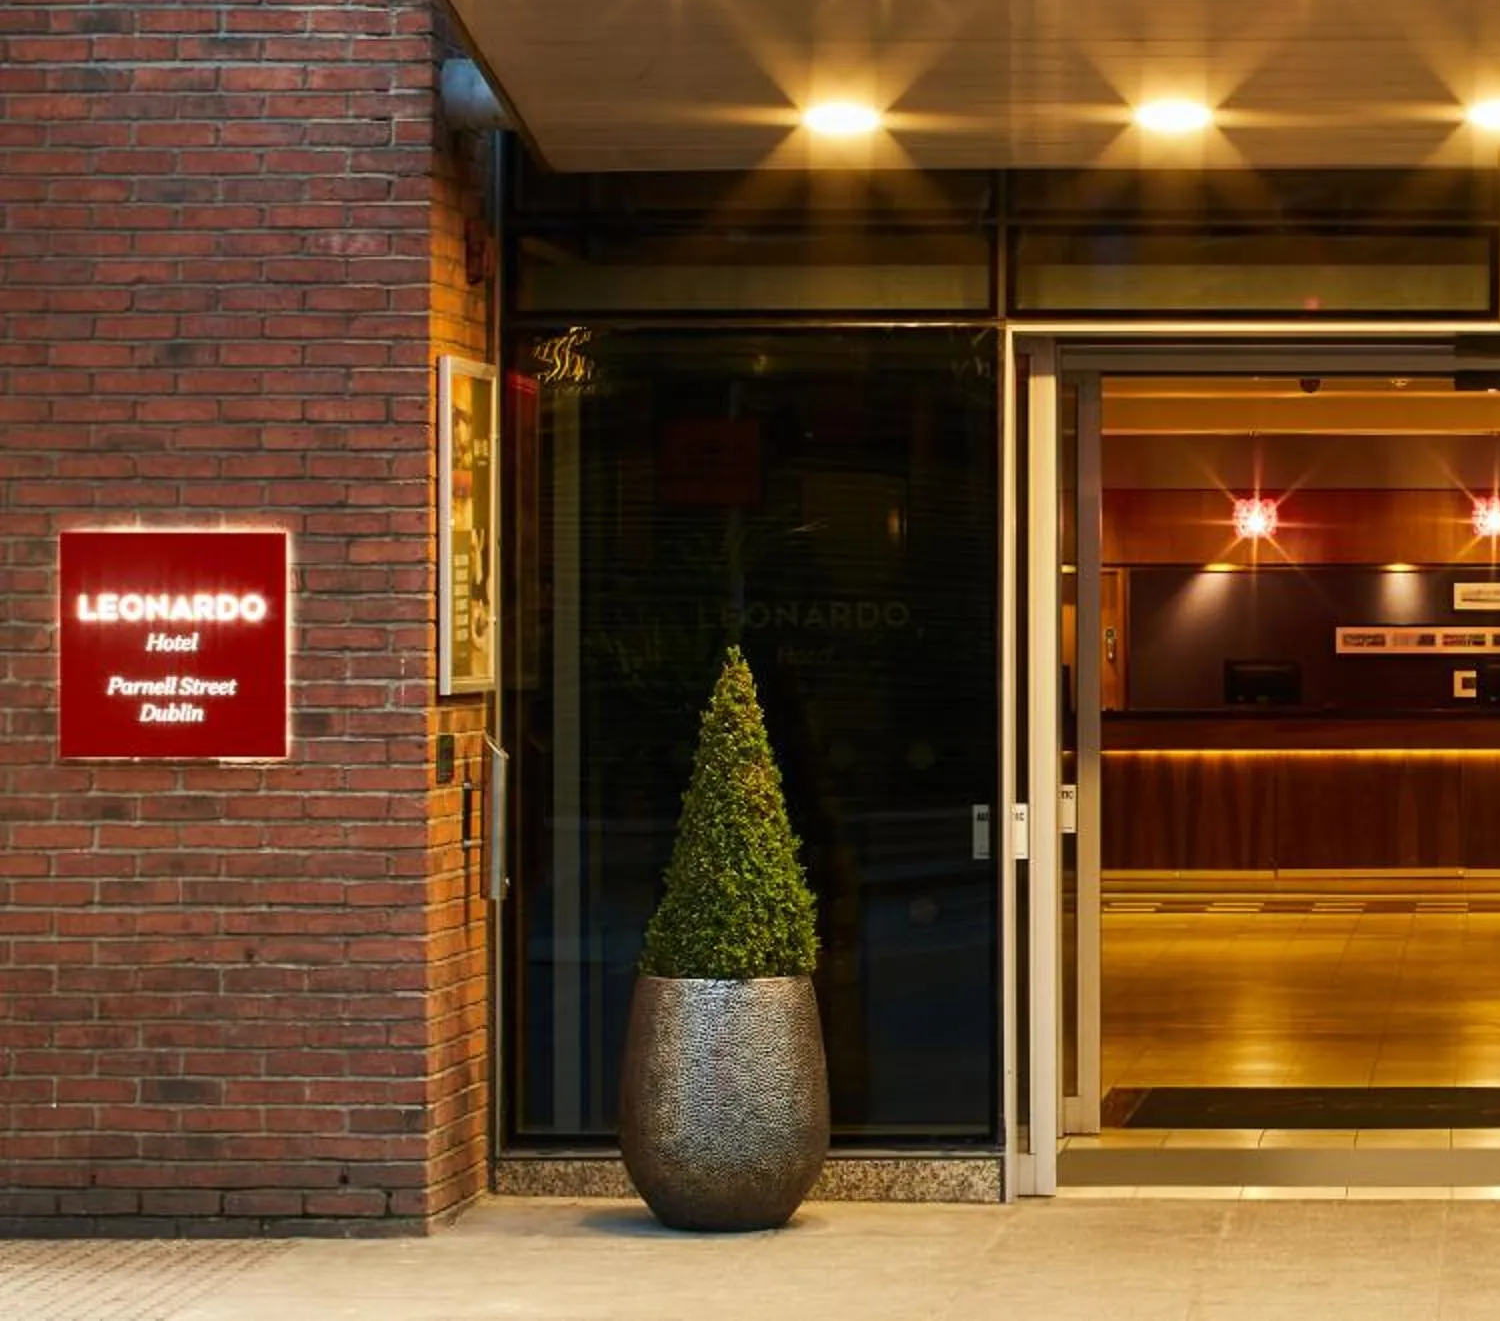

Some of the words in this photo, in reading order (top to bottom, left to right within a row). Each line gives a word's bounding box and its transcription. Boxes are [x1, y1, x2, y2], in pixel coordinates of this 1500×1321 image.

[77, 593, 267, 622] LEONARDO
[145, 632, 199, 652] Hotel
[107, 676, 177, 696] Parnell
[179, 677, 238, 696] Street
[139, 703, 205, 722] Dublin
